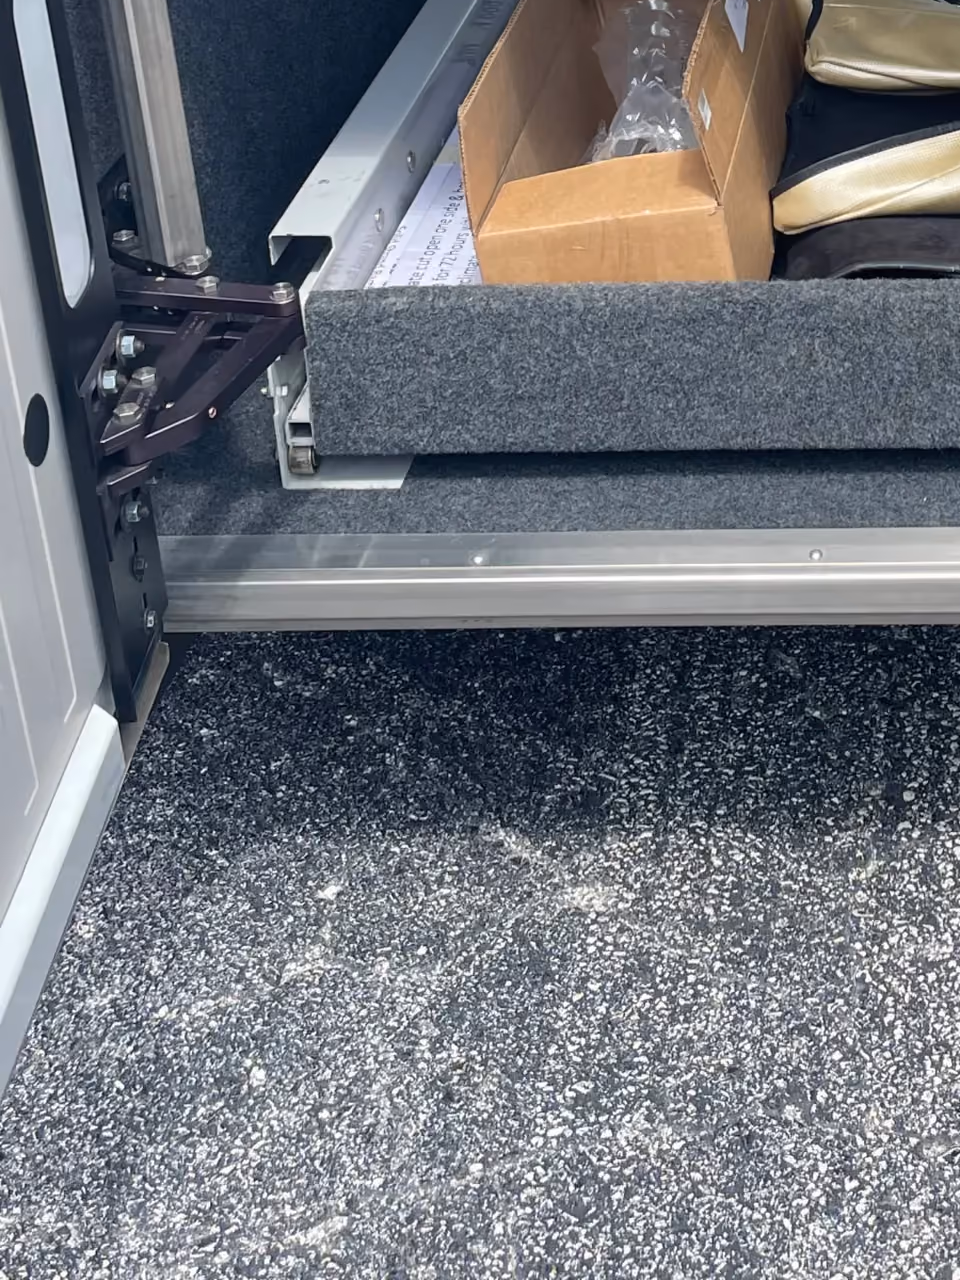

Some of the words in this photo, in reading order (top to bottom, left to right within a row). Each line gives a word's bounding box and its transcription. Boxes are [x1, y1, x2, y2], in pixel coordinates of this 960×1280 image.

[442, 201, 461, 218] side
[435, 218, 453, 234] one
[423, 234, 442, 256] open
[444, 232, 471, 256] hours
